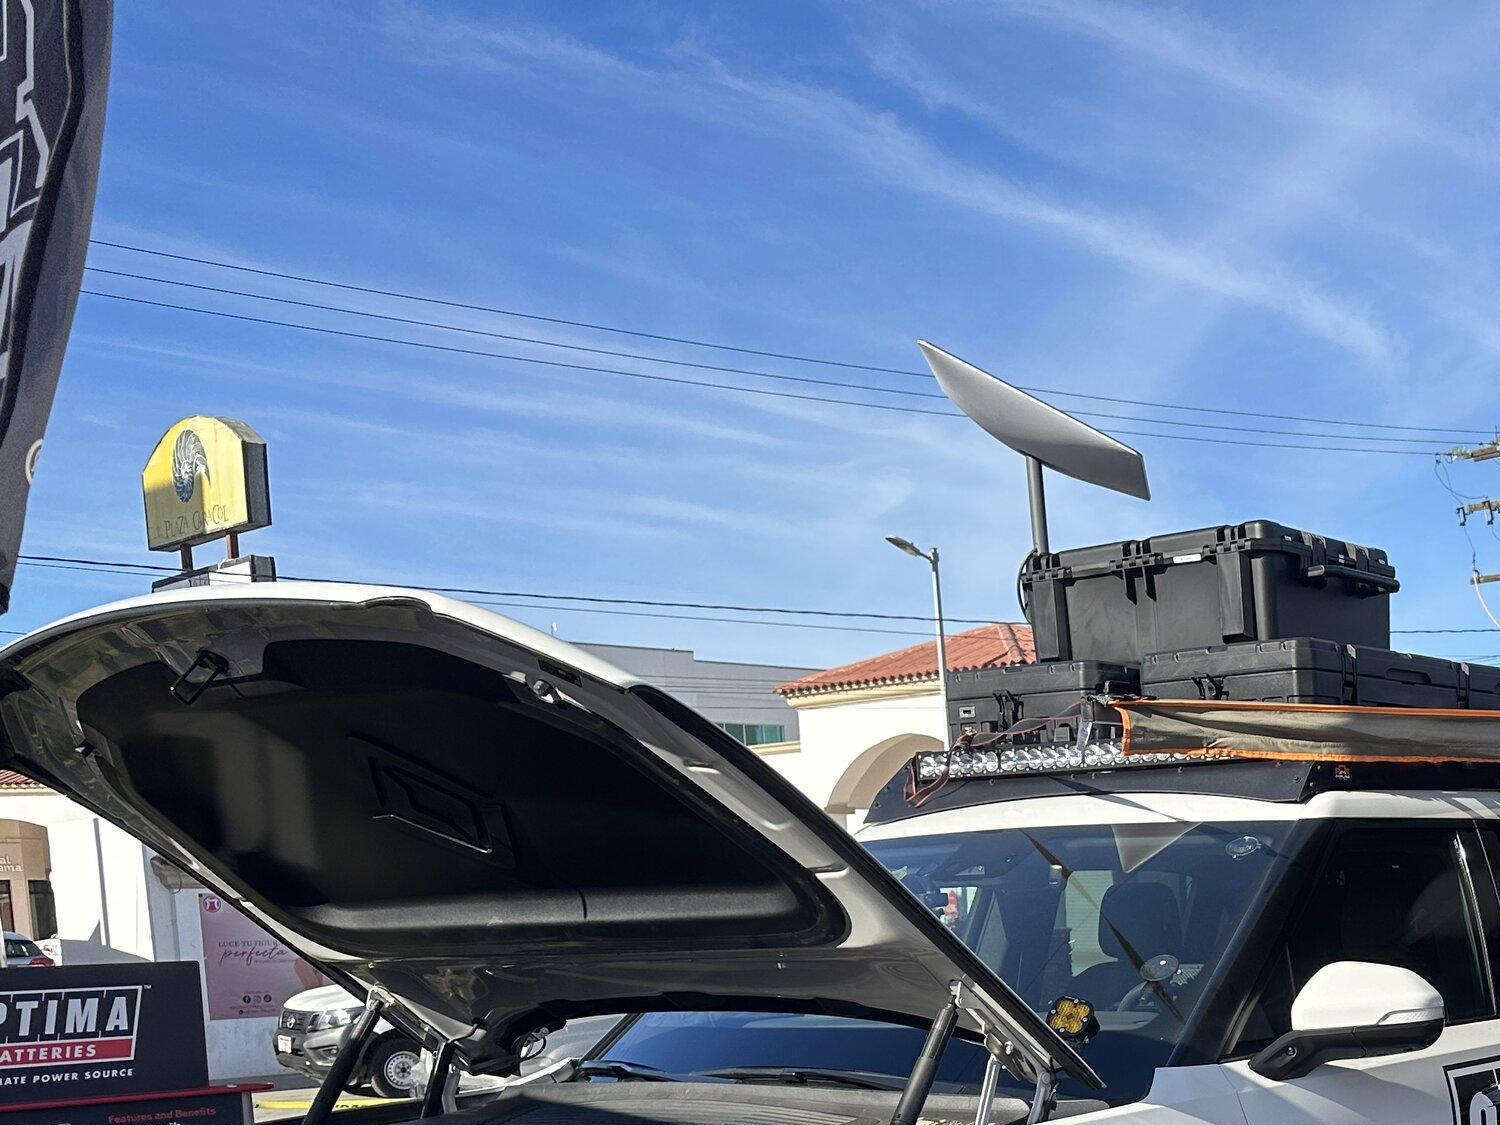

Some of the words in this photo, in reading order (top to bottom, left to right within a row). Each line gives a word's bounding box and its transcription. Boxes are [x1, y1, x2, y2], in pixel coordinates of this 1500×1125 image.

[220, 944, 288, 967] perfecta
[32, 1072, 79, 1084] POWER
[84, 1068, 134, 1080] SOURCE
[108, 1113, 154, 1124] Features
[155, 1110, 173, 1120] and
[175, 1107, 216, 1118] Benefits
